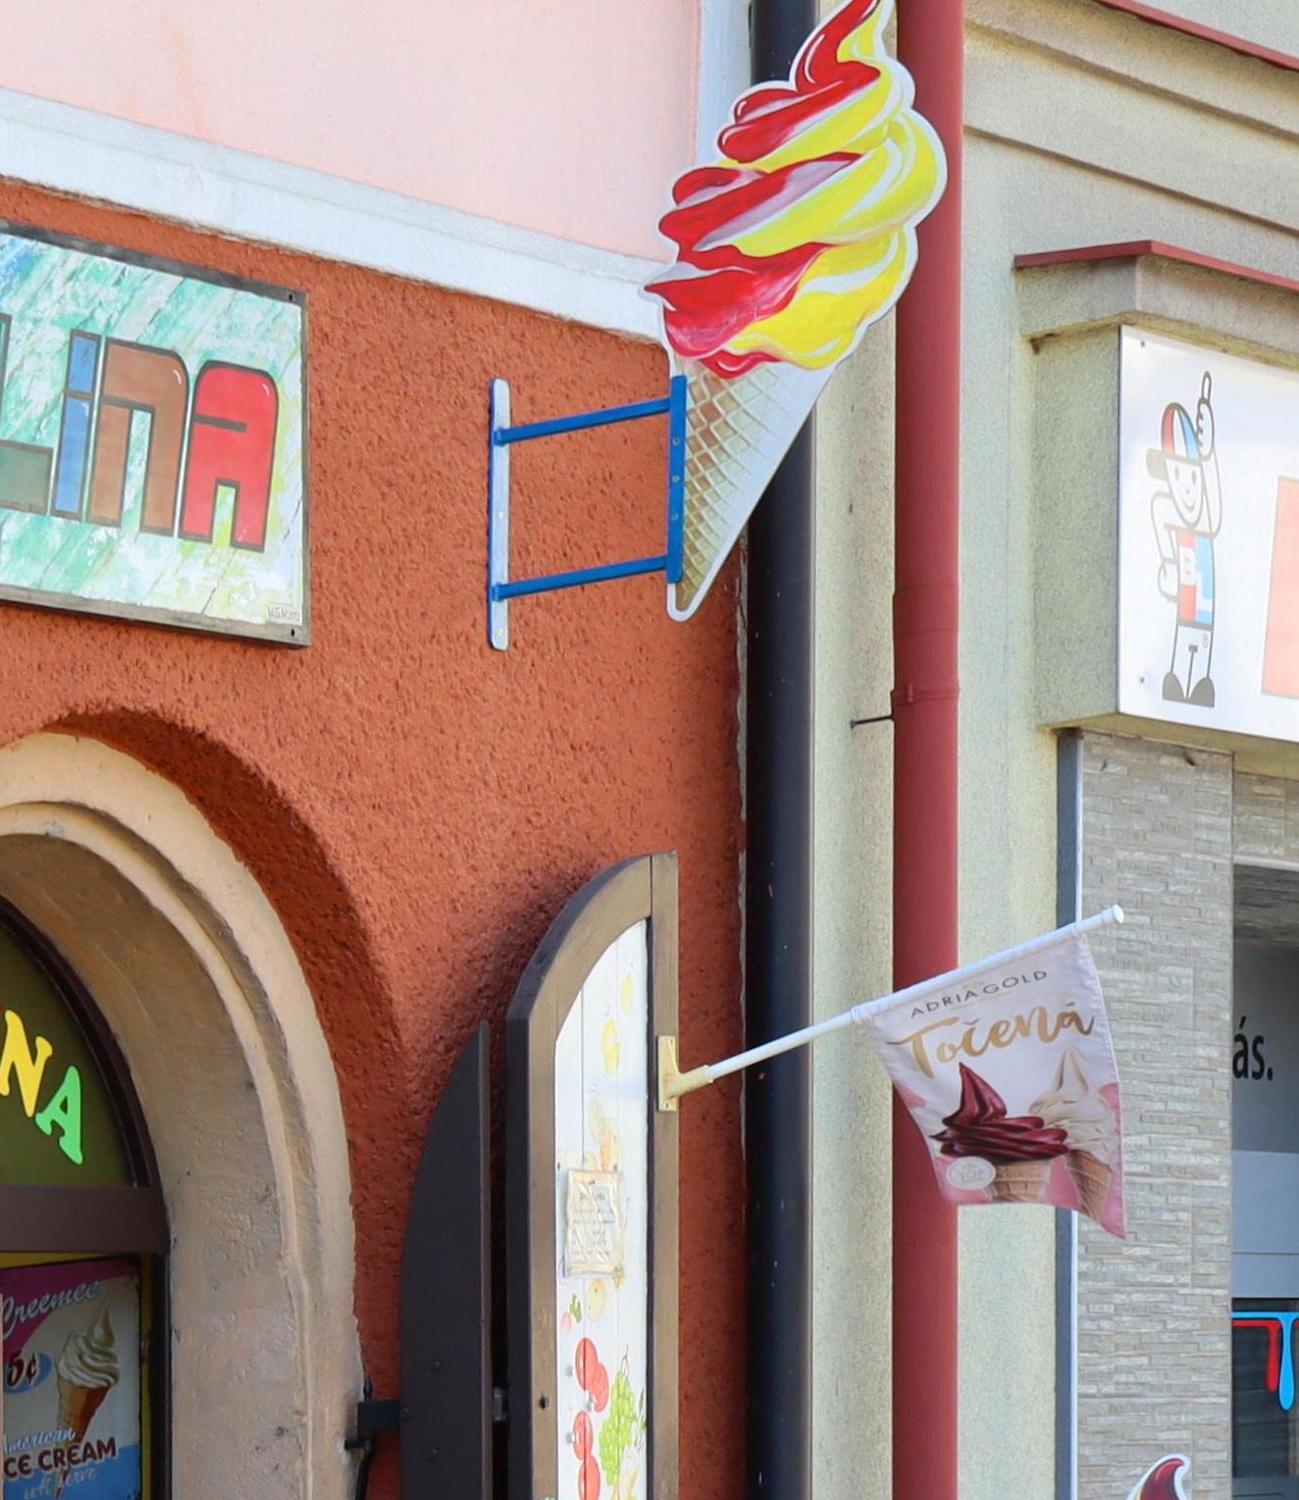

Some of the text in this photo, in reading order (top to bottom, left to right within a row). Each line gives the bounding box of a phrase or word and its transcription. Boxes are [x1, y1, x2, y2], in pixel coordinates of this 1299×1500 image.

[910, 969, 1049, 1019] ADRIA GOLD
[886, 1001, 1094, 1079] Točená
[1232, 1015, 1273, 1081] ás.
[4, 1436, 117, 1478] CE CREAM
